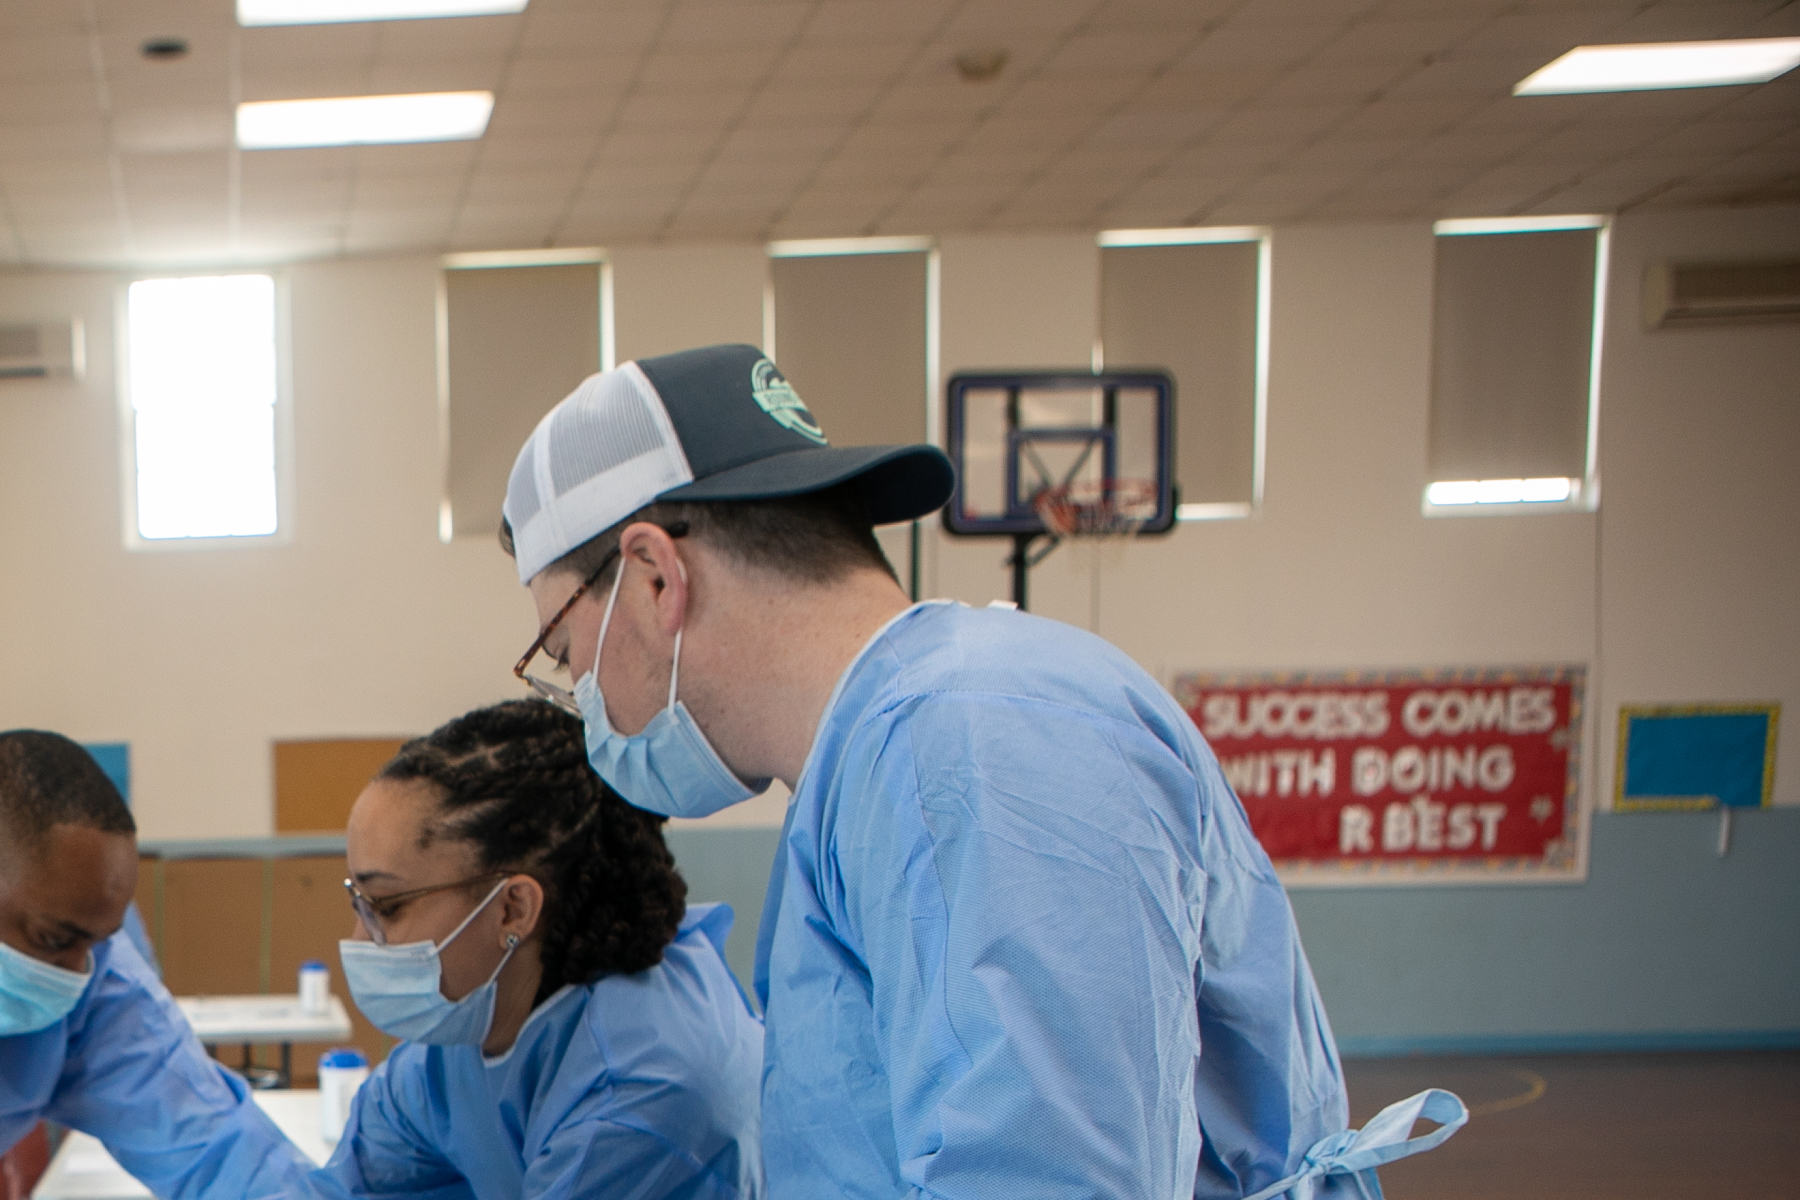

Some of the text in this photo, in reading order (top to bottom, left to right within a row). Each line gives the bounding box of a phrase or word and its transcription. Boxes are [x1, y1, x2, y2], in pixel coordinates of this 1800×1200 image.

[1202, 687, 1556, 740] SUCCESS COMES
[1222, 744, 1517, 797] WITH DOING
[1381, 800, 1509, 854] BEST
